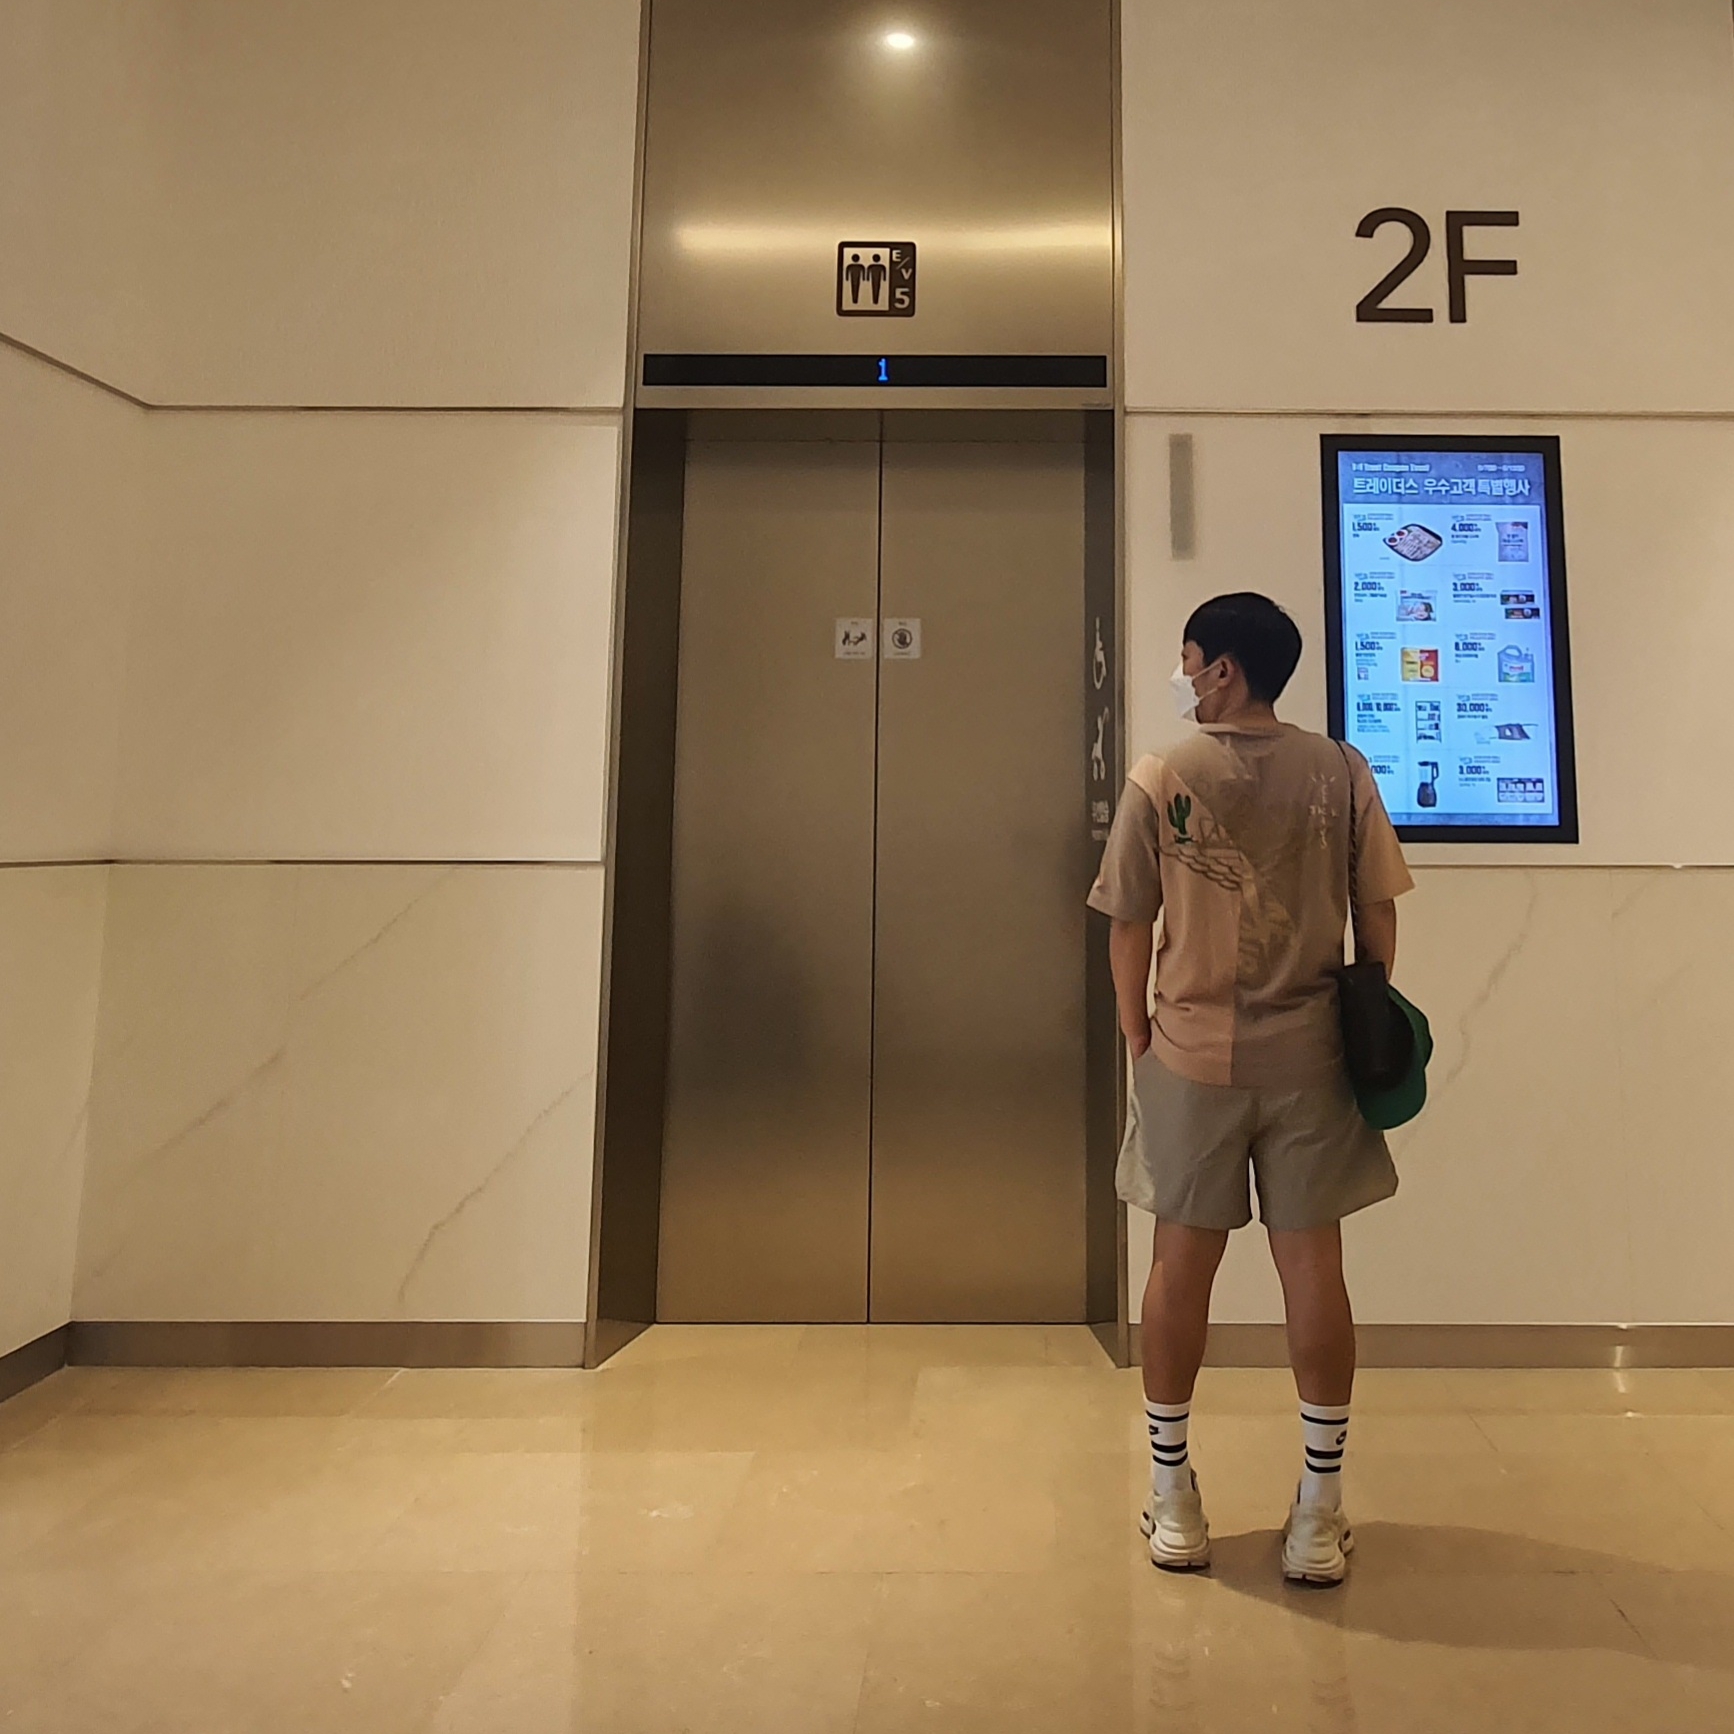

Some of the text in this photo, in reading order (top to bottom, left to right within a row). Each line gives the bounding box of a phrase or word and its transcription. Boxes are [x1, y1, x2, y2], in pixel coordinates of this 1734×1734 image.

[1355, 207, 1519, 324] 2F
[894, 287, 910, 309] 5
[878, 358, 889, 381] 1
[1352, 477, 1419, 495] 트레이더스
